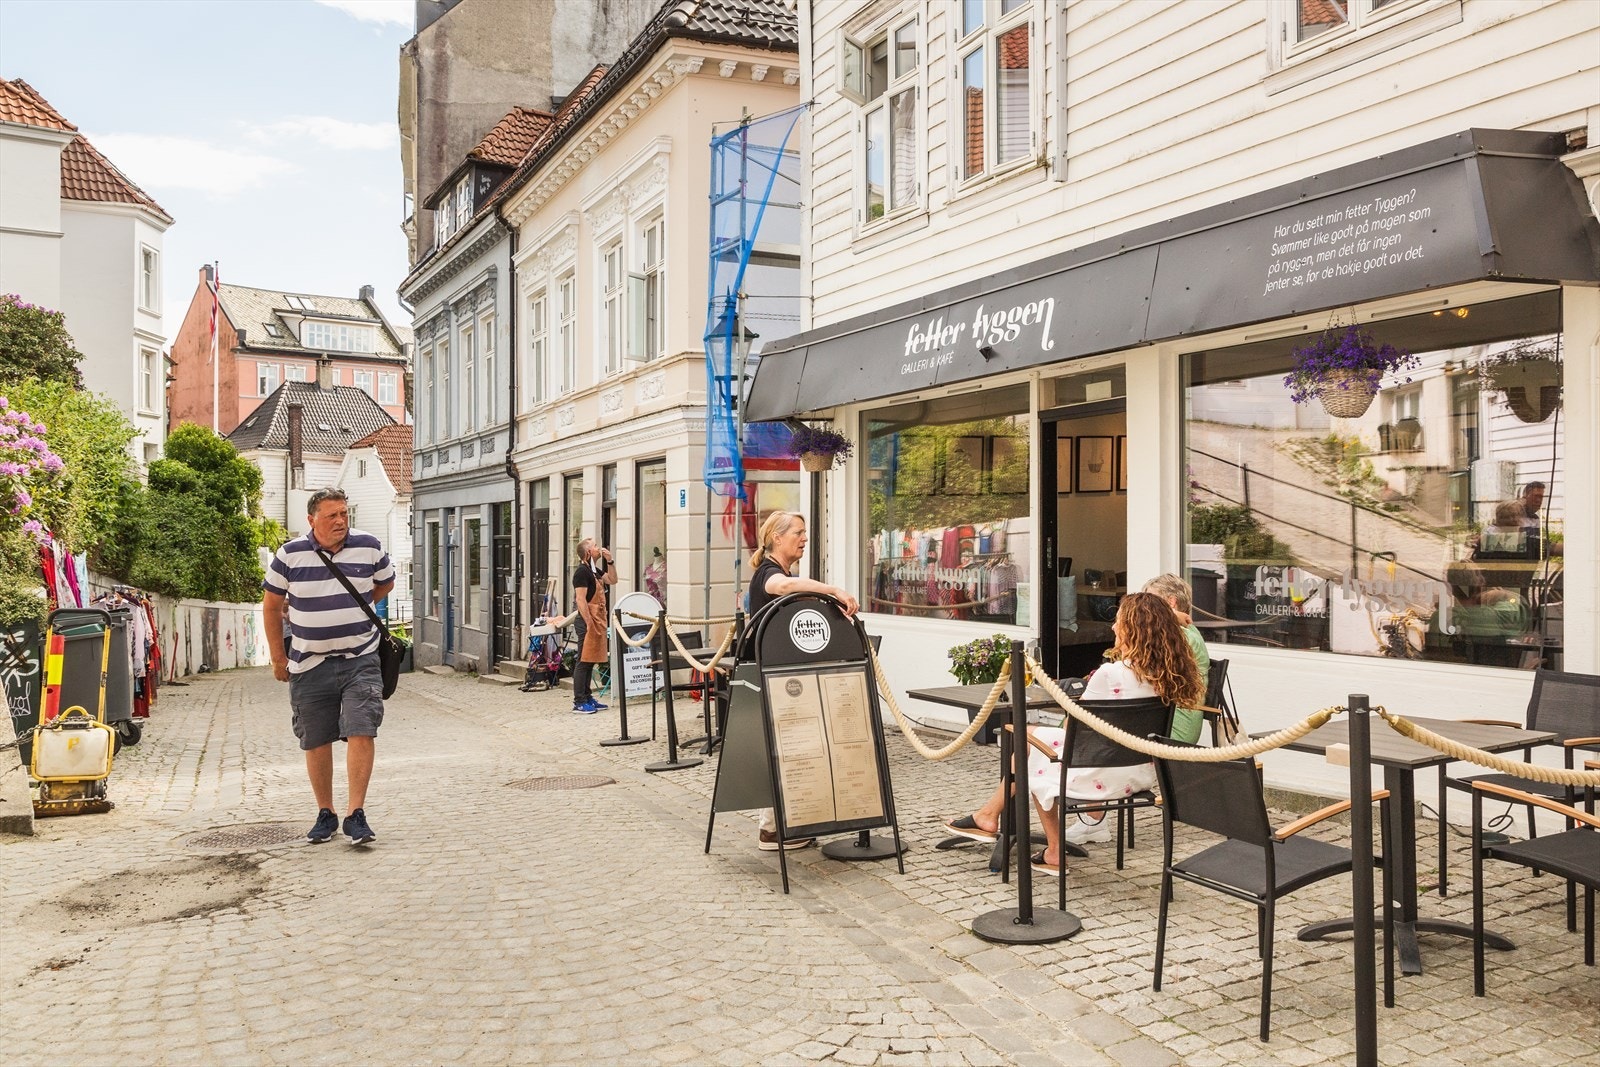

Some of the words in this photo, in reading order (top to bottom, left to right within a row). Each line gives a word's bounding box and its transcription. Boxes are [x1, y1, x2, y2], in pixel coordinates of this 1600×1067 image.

[1271, 236, 1312, 256] Svømmer
[1314, 232, 1330, 247] like
[1331, 227, 1353, 244] godt
[1354, 222, 1369, 238] på
[1371, 214, 1406, 233] magen
[1408, 206, 1431, 222] som
[1274, 224, 1290, 239] Har
[1292, 220, 1304, 234] du
[1306, 215, 1324, 231] sett
[1325, 210, 1343, 228] min
[1345, 202, 1372, 222] fetter
[1374, 188, 1416, 213] Tyggen?
[1263, 275, 1290, 296] jenter
[1292, 274, 1304, 288] se,
[1306, 270, 1320, 283] for
[1322, 266, 1334, 280] de
[1336, 259, 1362, 278] hakje
[1364, 254, 1387, 274] godt
[1390, 253, 1402, 265] av
[1404, 244, 1425, 262] det.
[1268, 262, 1280, 278] på
[1282, 256, 1314, 274] ryggen,
[1316, 250, 1336, 265] men
[1338, 244, 1354, 258] det
[1356, 238, 1371, 254] får
[1373, 233, 1402, 251] ingen
[904, 316, 966, 356] fetter
[972, 298, 1054, 351] tyggen
[901, 359, 928, 374] GALLERI
[930, 356, 935, 368] &
[797, 620, 823, 628] fetter
[1254, 566, 1334, 600] fetter
[1342, 567, 1456, 635] tyggen
[1256, 604, 1290, 616] GALLERI
[1294, 606, 1301, 616] &
[795, 627, 828, 641] tyggen
